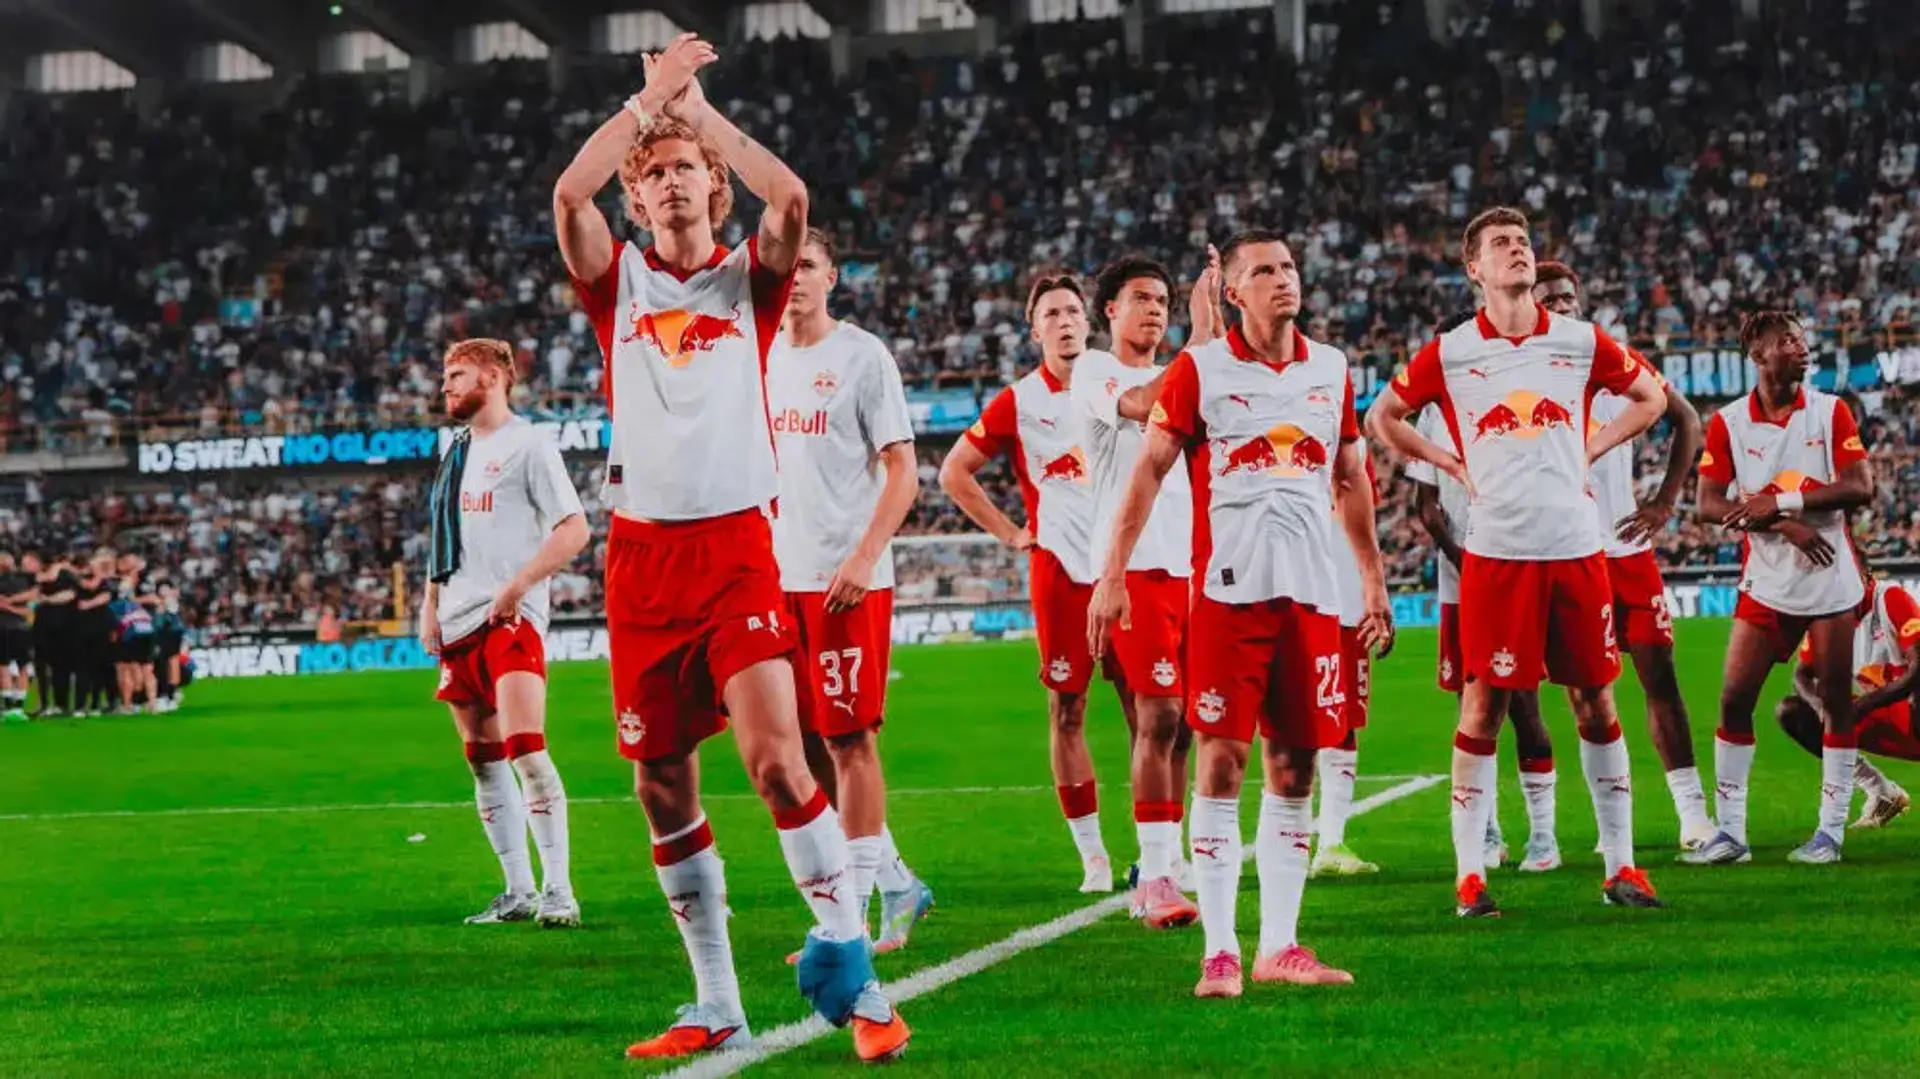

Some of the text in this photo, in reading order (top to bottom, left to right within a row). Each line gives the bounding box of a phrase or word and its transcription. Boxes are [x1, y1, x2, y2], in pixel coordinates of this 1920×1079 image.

[788, 409, 828, 436] Bull
[174, 436, 284, 471] SWEAT
[462, 491, 493, 512] Bull
[819, 647, 862, 696] 37
[1315, 652, 1345, 708] 22
